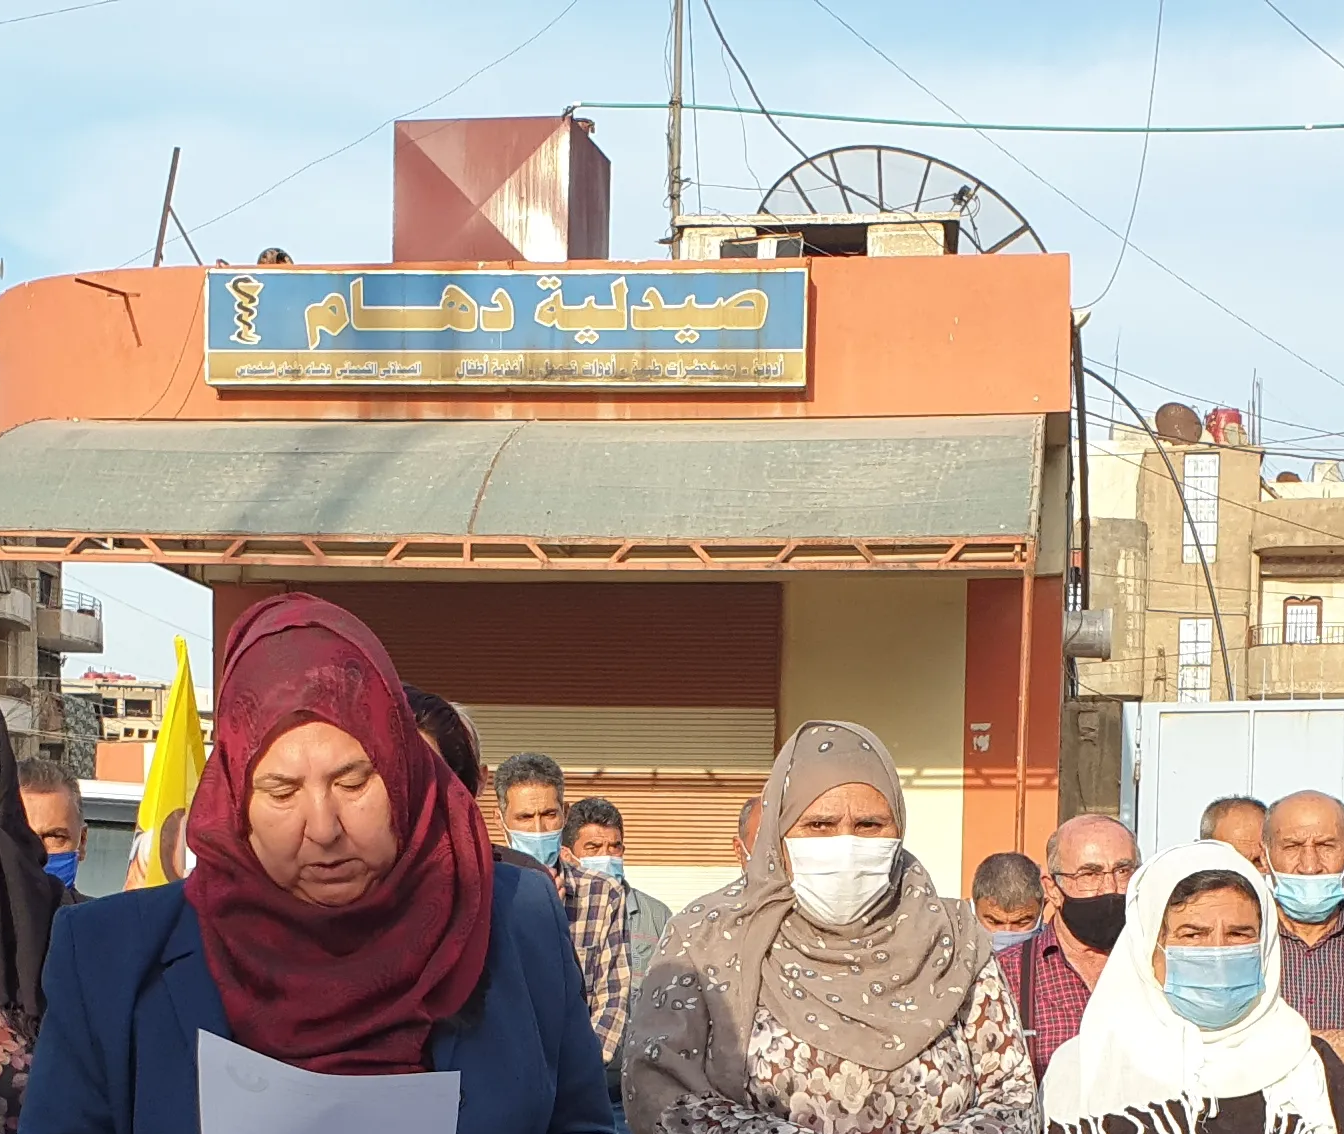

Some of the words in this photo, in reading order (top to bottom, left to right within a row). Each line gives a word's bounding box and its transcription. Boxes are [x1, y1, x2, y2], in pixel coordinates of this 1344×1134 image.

[304, 276, 515, 350] دهام
[534, 276, 769, 345] صيدلية
[455, 353, 490, 380] أطفال
